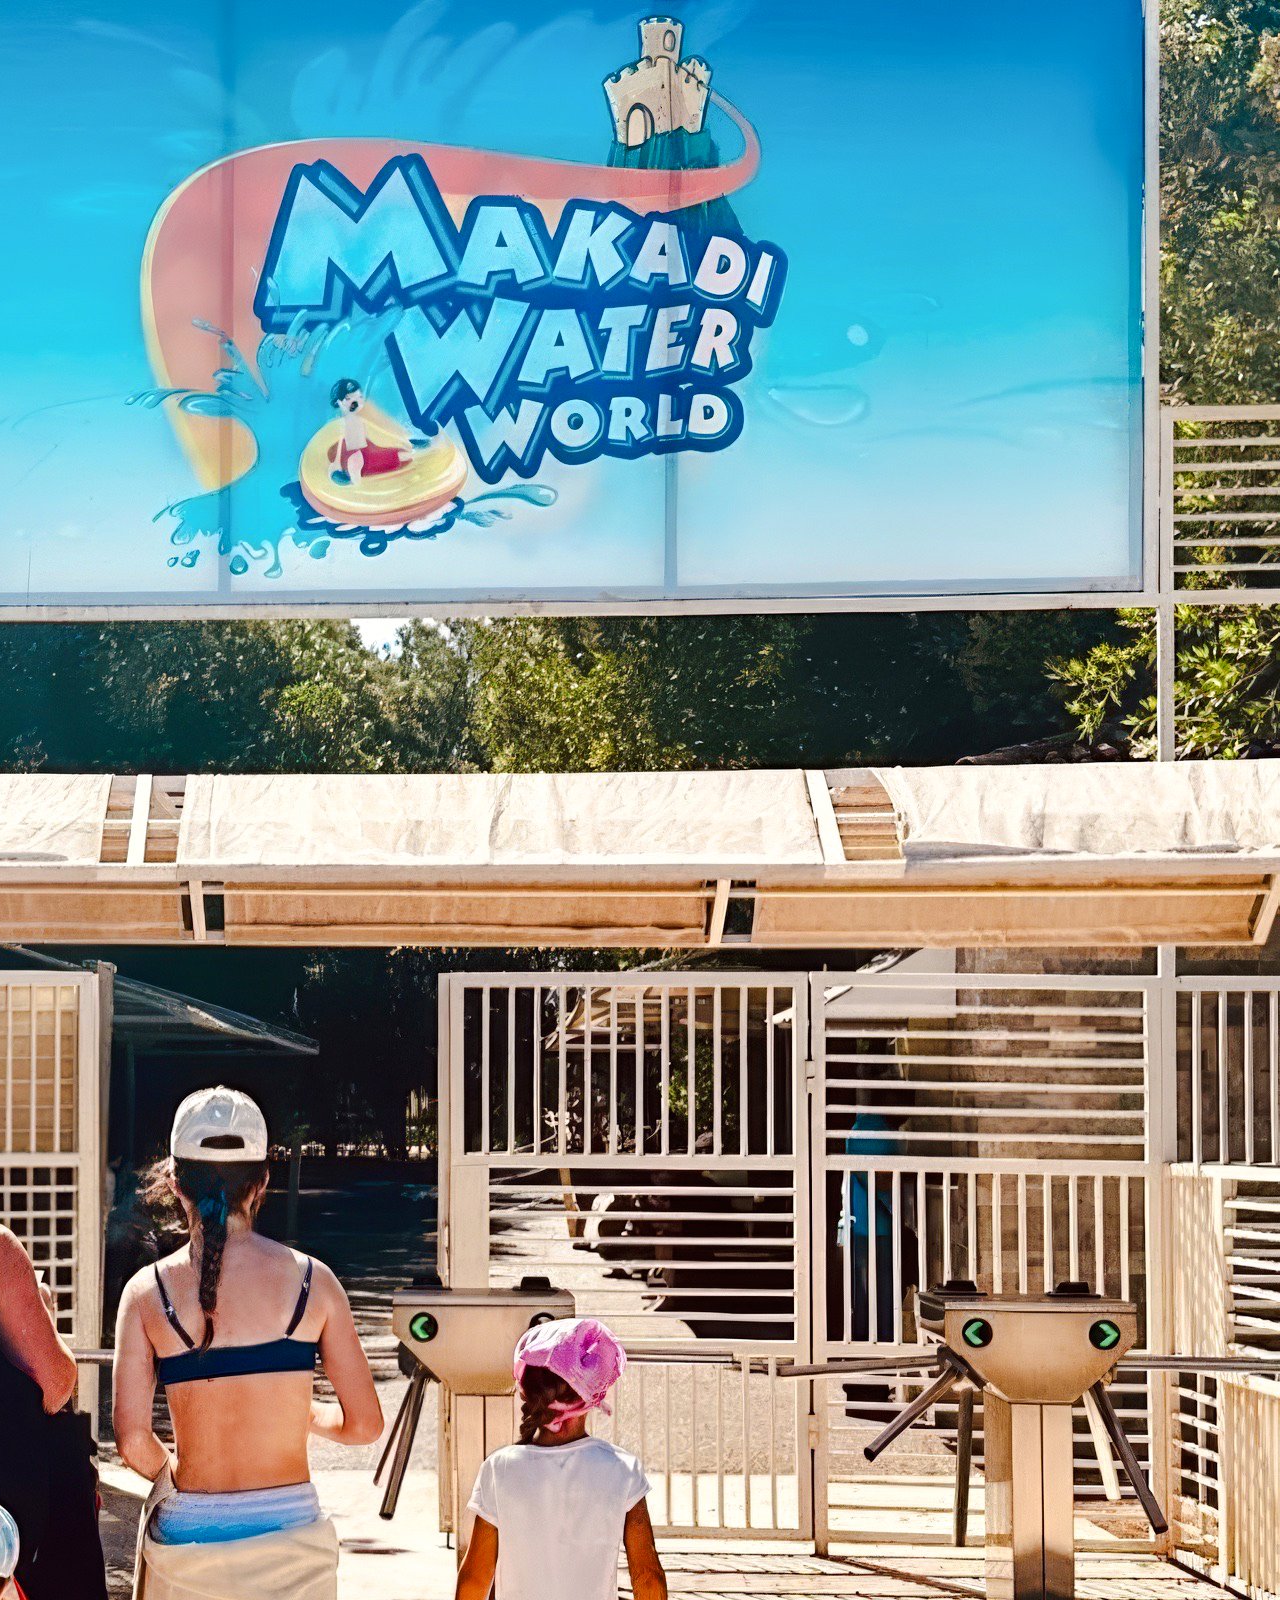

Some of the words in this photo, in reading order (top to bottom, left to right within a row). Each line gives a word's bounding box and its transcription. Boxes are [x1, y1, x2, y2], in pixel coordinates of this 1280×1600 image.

[263, 164, 776, 308] MAKADI
[392, 296, 739, 416] WATER
[463, 392, 729, 467] WORLD
